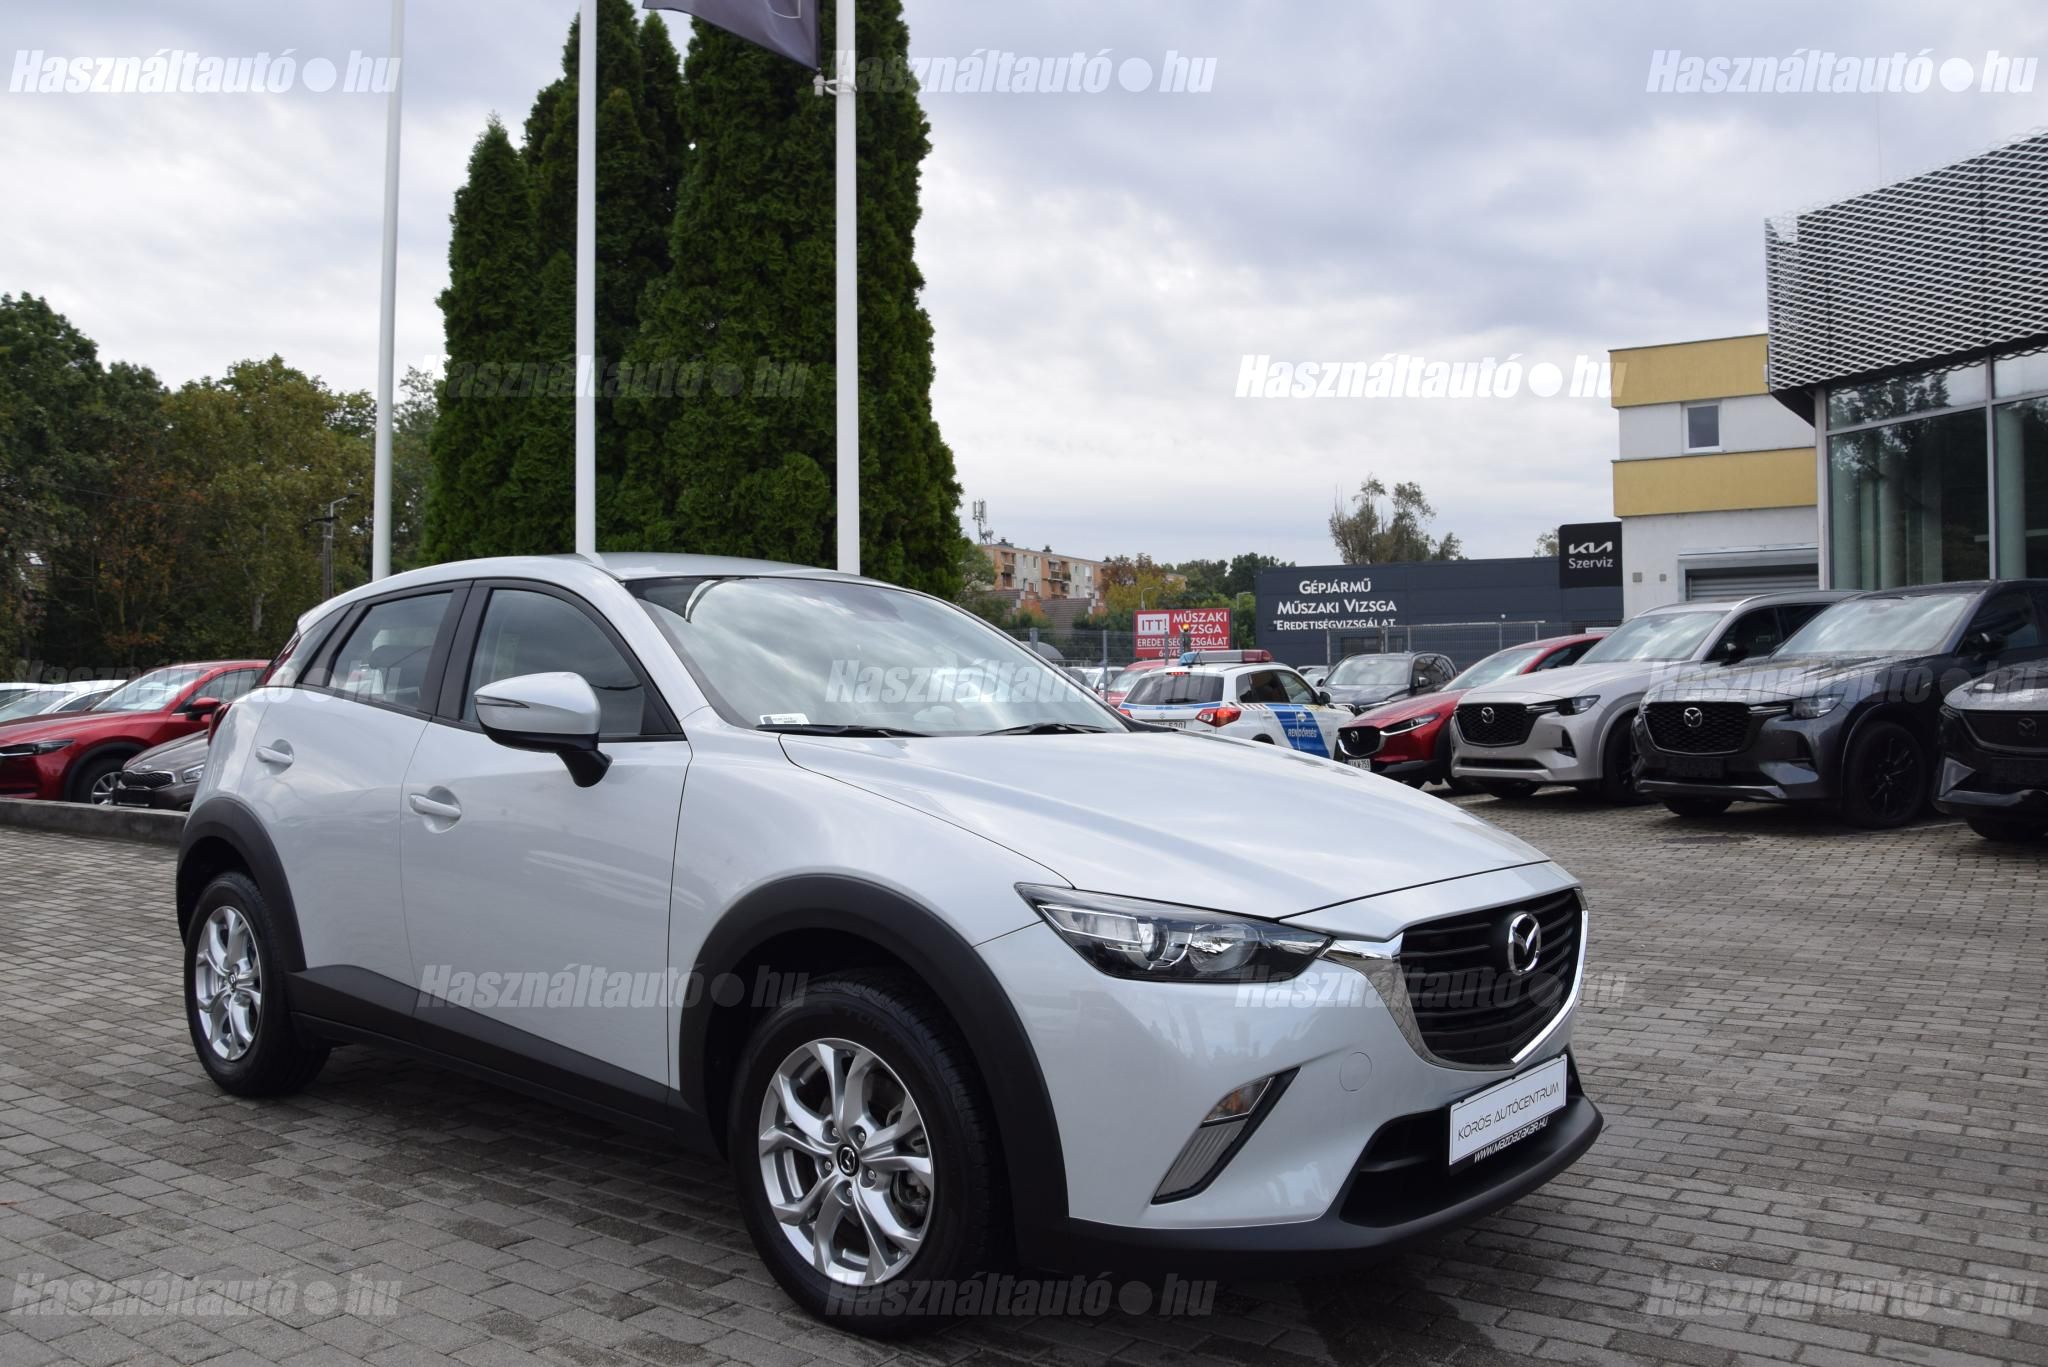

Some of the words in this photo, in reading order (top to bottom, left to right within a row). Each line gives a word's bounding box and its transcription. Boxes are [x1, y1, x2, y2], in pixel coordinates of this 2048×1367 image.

[1568, 556, 1614, 569] Szerviz
[1141, 618, 1168, 632] ITT!
[1178, 623, 1223, 635] VZSGA
